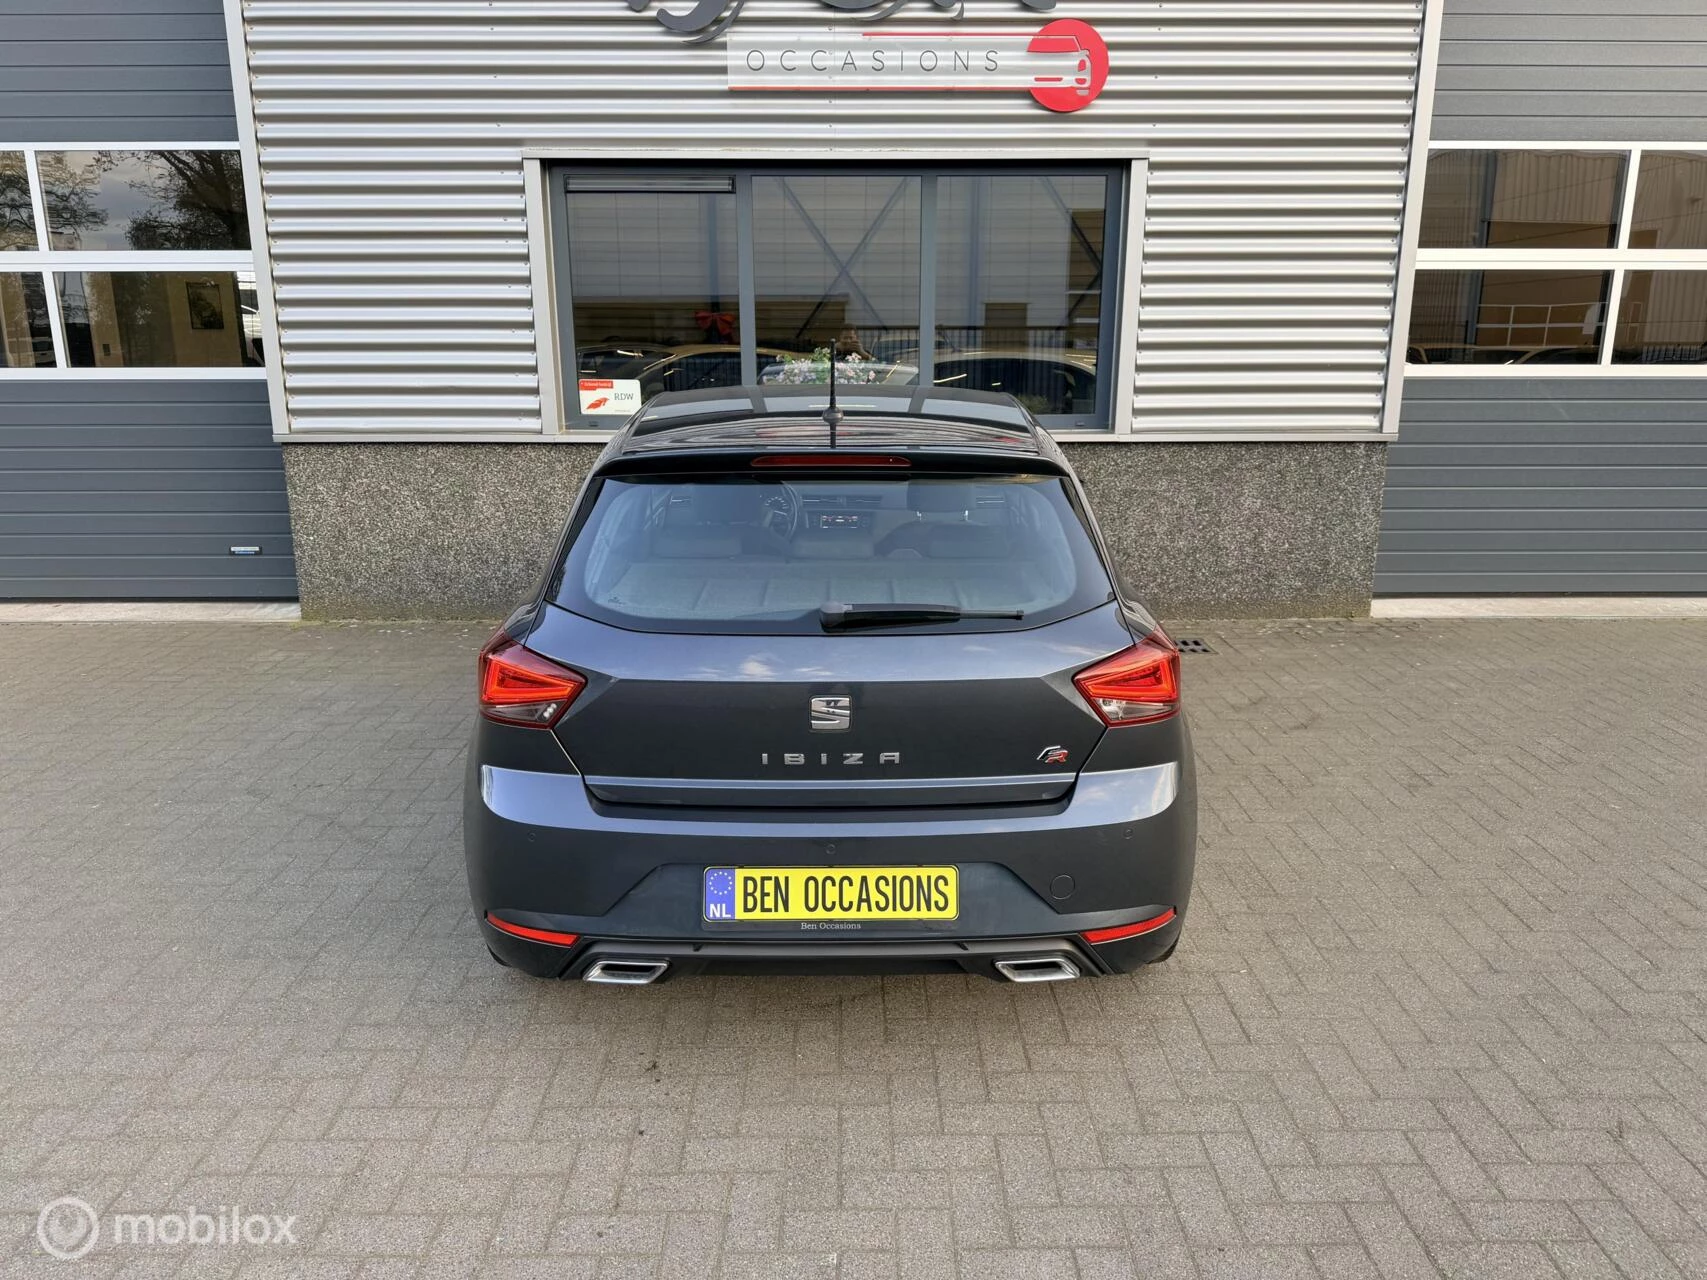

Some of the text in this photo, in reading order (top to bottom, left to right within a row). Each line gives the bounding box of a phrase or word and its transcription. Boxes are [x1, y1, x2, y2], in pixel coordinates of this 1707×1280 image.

[745, 49, 999, 72] OCCASIONS
[614, 392, 634, 401] RDW
[761, 751, 900, 765] IBIZA
[742, 875, 949, 913] BEN OCCASIONS
[709, 903, 731, 918] NL
[800, 921, 862, 930] Ben Occasions
